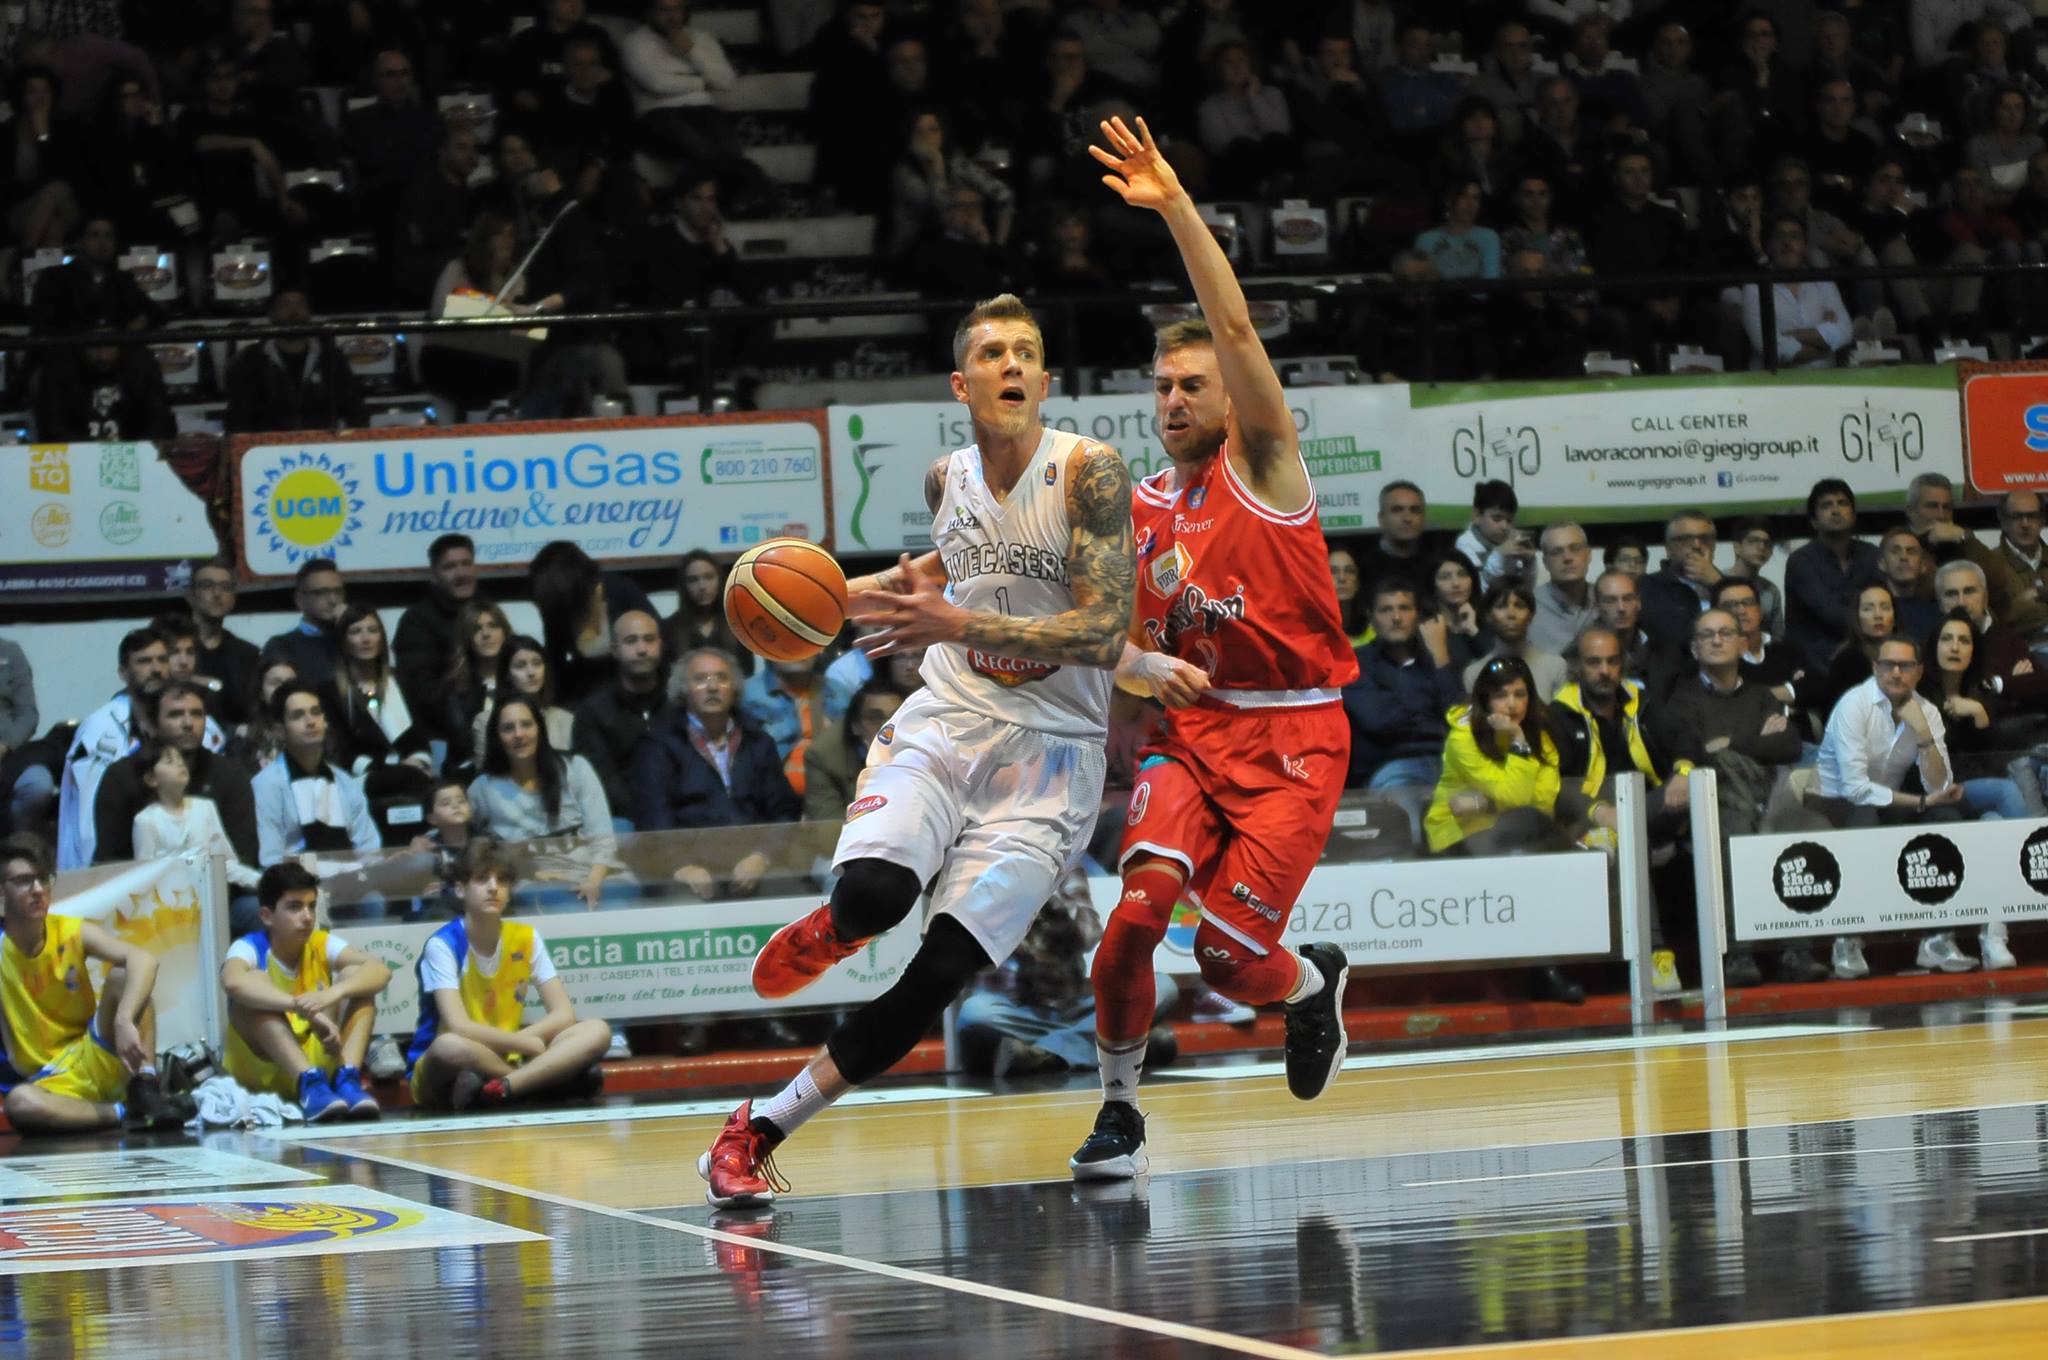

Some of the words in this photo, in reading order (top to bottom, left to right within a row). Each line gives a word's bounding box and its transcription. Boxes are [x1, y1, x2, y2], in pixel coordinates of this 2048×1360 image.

[1631, 416, 1674, 431] CALL
[1680, 413, 1749, 430] CENTER
[1565, 435, 1819, 462] lavoraconnoi@giegigroup.it
[374, 443, 682, 497] UnionGas
[715, 460, 745, 476] 800
[751, 459, 778, 475] 210
[783, 457, 812, 473] 760
[37, 468, 65, 486] TO
[1607, 474, 1707, 490] www.giegigroup.it
[275, 496, 342, 519] UGM
[380, 500, 520, 535] metano
[562, 497, 685, 549] energy
[1127, 781, 1151, 826] 9
[1781, 856, 1807, 873] up
[1905, 848, 1931, 865] up
[1782, 872, 1815, 886] the
[1907, 864, 1939, 878] the
[1908, 871, 1958, 889] meat
[1783, 879, 1834, 897] meat
[1246, 893, 1282, 924] Emak
[1370, 889, 1516, 930] Caserta
[1879, 914, 1893, 922] VIA
[1939, 910, 1949, 919] 25
[1955, 907, 1989, 917] CASERTA
[2002, 904, 2016, 914] VIA
[1754, 922, 1768, 931] VIA
[1815, 919, 1825, 928] 25
[1831, 915, 1866, 926] CASERTA
[636, 928, 756, 961] marino
[599, 966, 654, 981] CASERTA
[663, 966, 685, 977] TEL
[687, 966, 695, 976] E
[697, 964, 720, 975] FAX
[846, 966, 897, 983] marino
